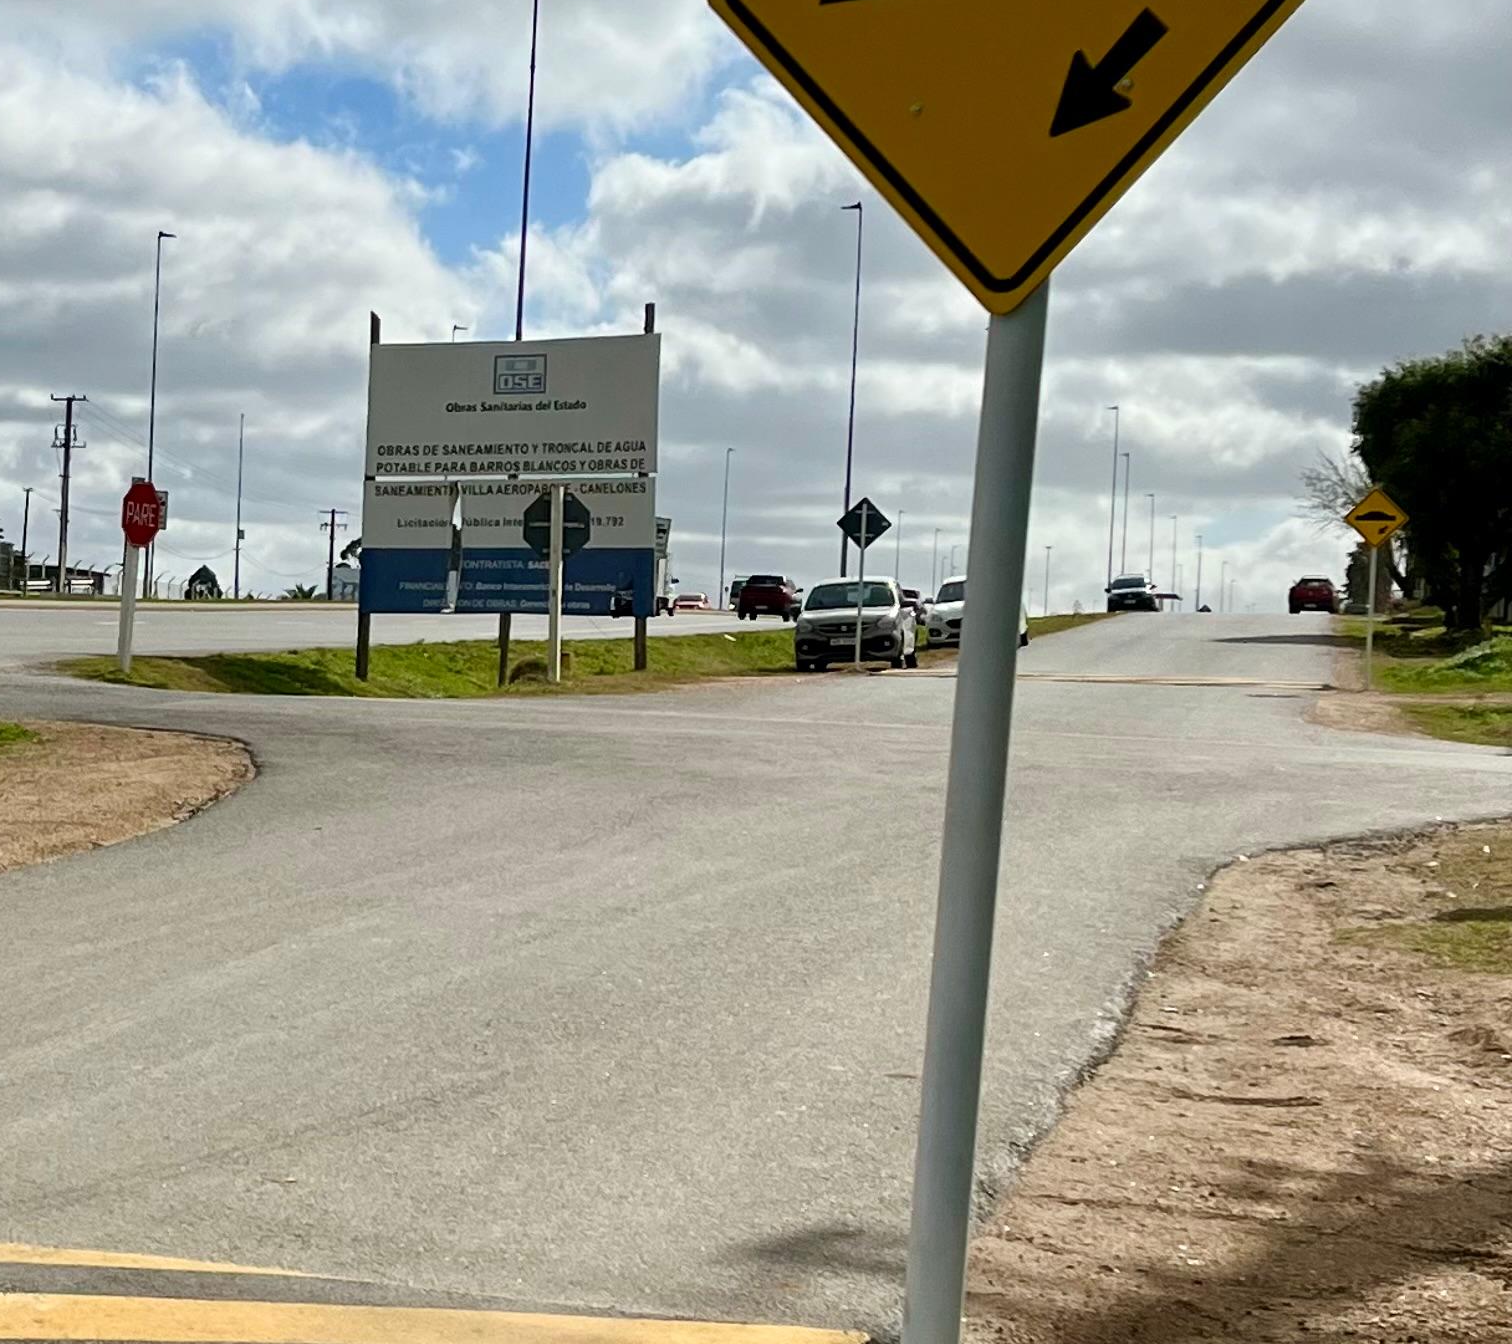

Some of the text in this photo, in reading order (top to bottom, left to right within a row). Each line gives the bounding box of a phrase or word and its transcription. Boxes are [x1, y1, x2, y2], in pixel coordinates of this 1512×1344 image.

[499, 375, 542, 390] OSE
[445, 399, 587, 413] Obras Sanitarias del Estado
[377, 440, 647, 456] OBRAS DE SANEAMIENTO Y TRONCAL DE AGUA
[376, 458, 646, 473] POTABLE PARA BARROS BLANCOS Y OBRAS DE
[461, 484, 494, 496] VILLA
[579, 482, 647, 495] CANELONES
[126, 501, 157, 527] PARE
